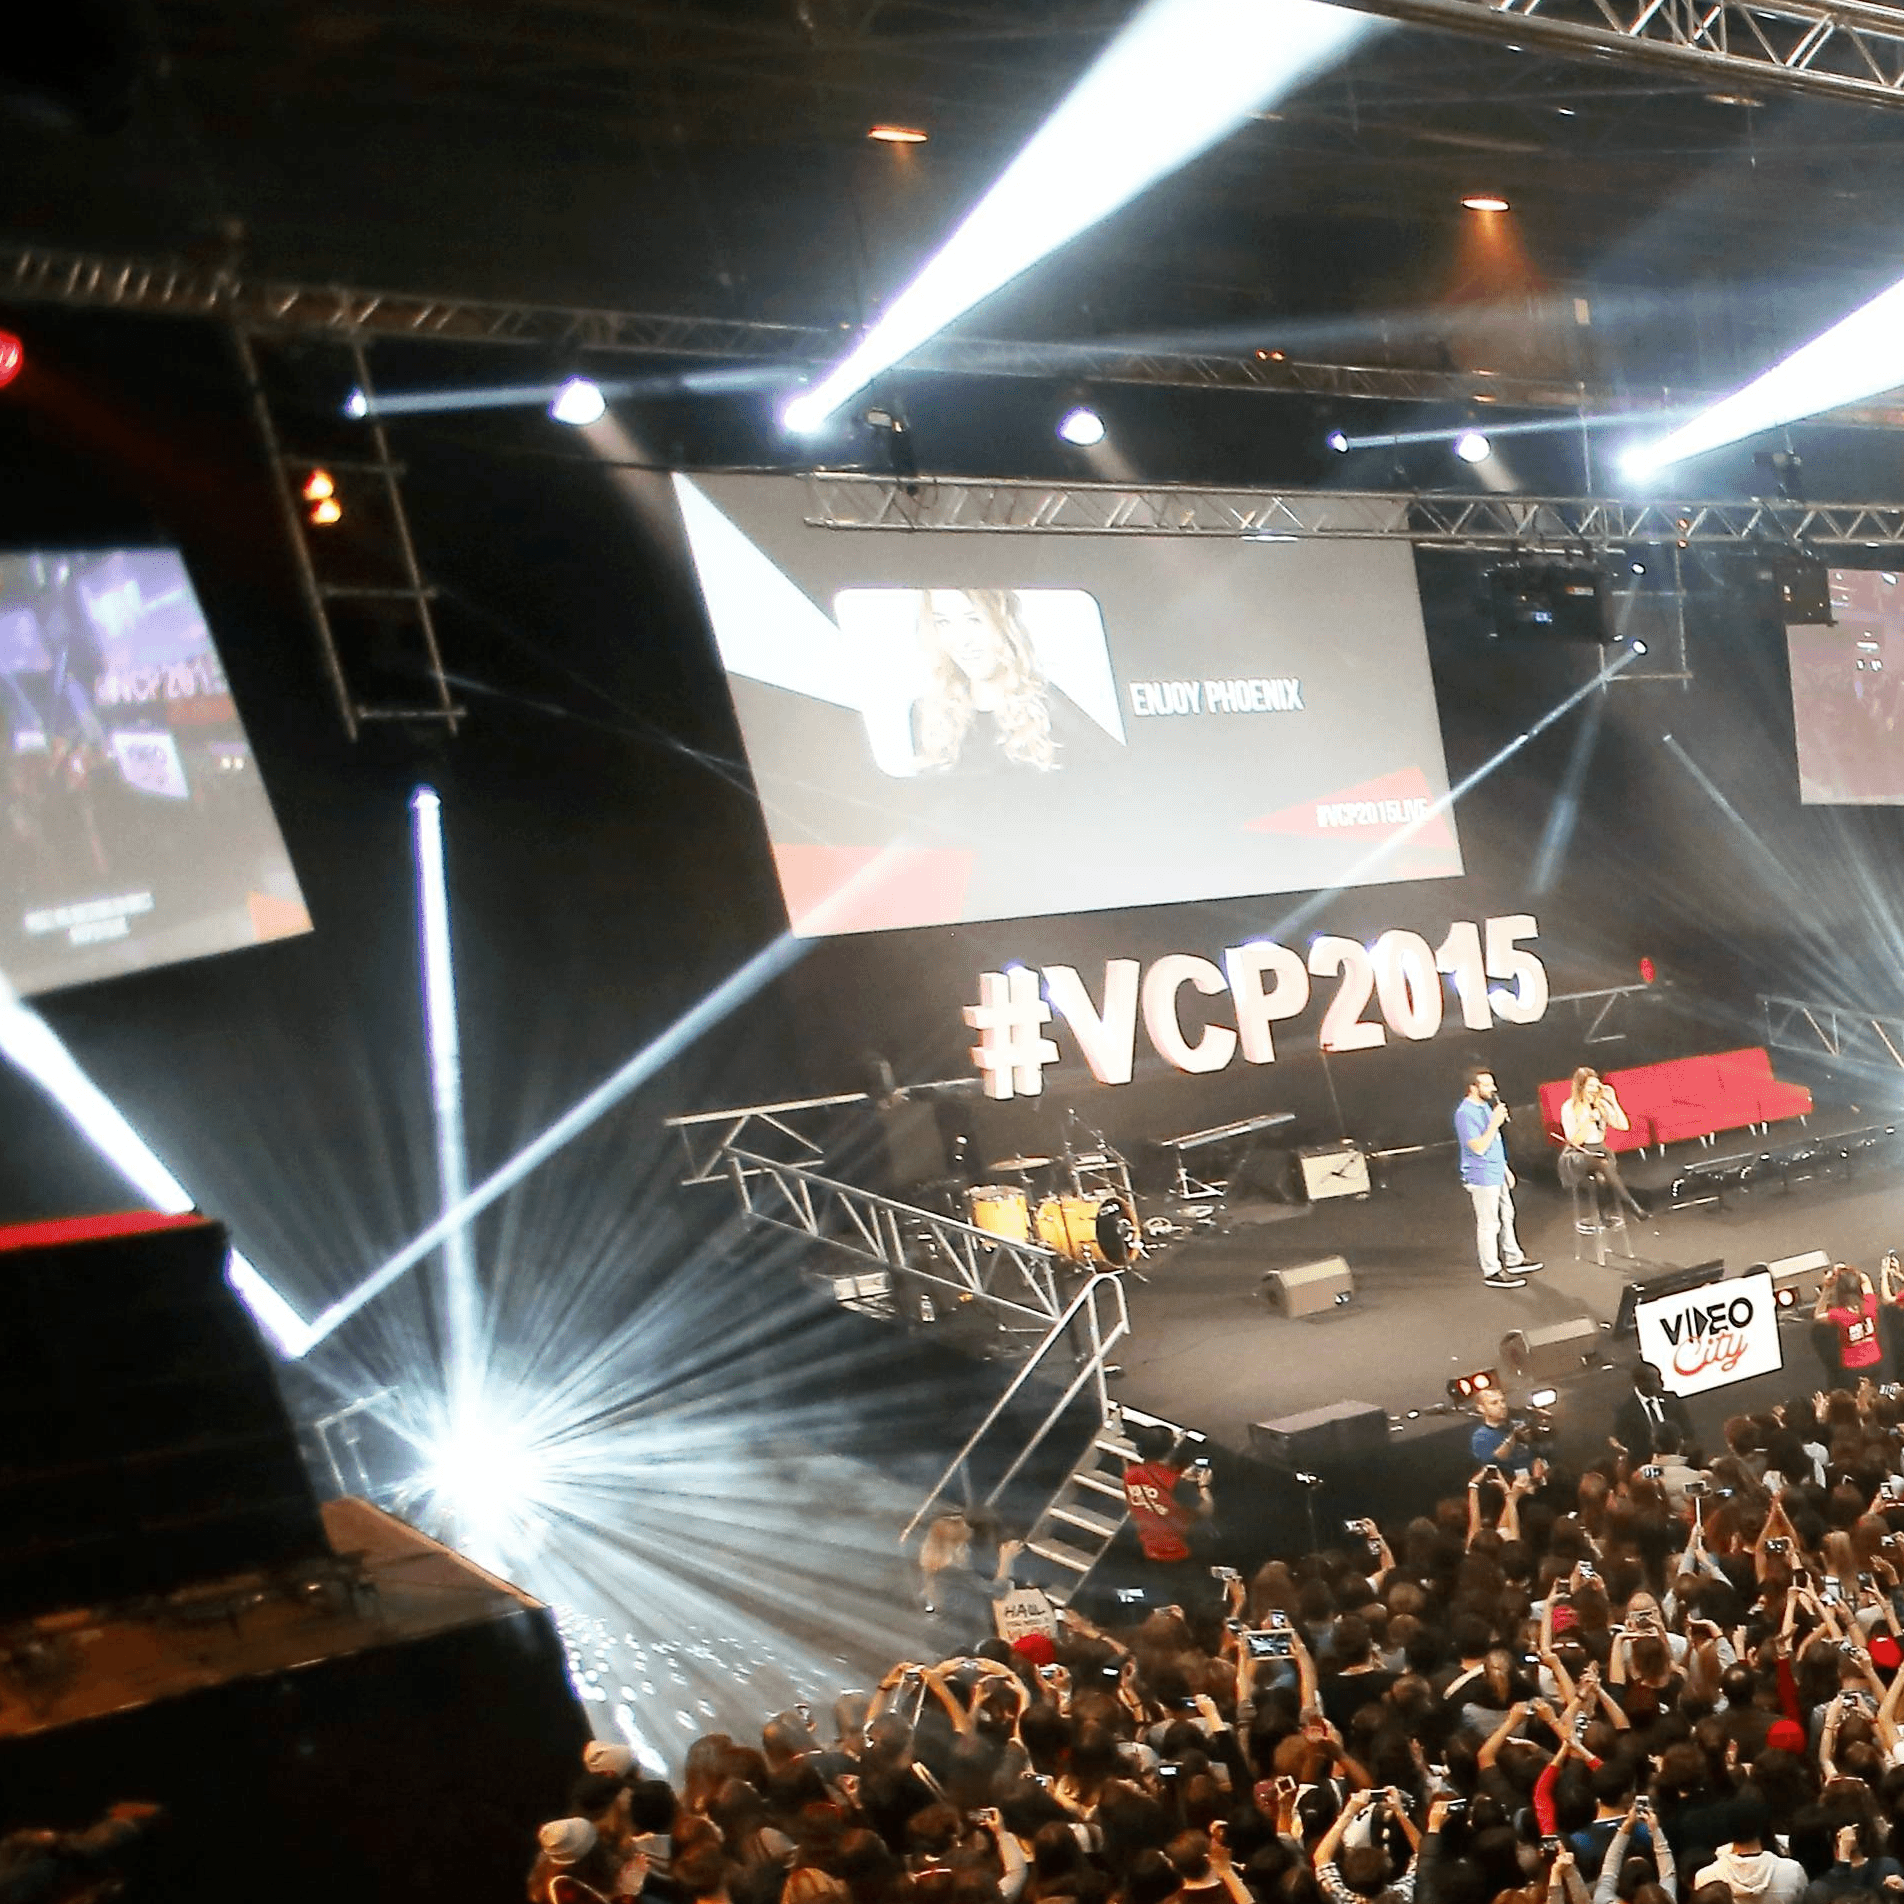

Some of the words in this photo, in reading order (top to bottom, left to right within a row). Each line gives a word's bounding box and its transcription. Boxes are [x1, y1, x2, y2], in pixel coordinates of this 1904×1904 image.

[1129, 680, 1201, 717] ENJOY
[1204, 677, 1305, 714] PHOENIX
[963, 912, 1550, 1100] #VCP2015
[1659, 1297, 1754, 1346] VIDEO
[1673, 1331, 1748, 1376] City
